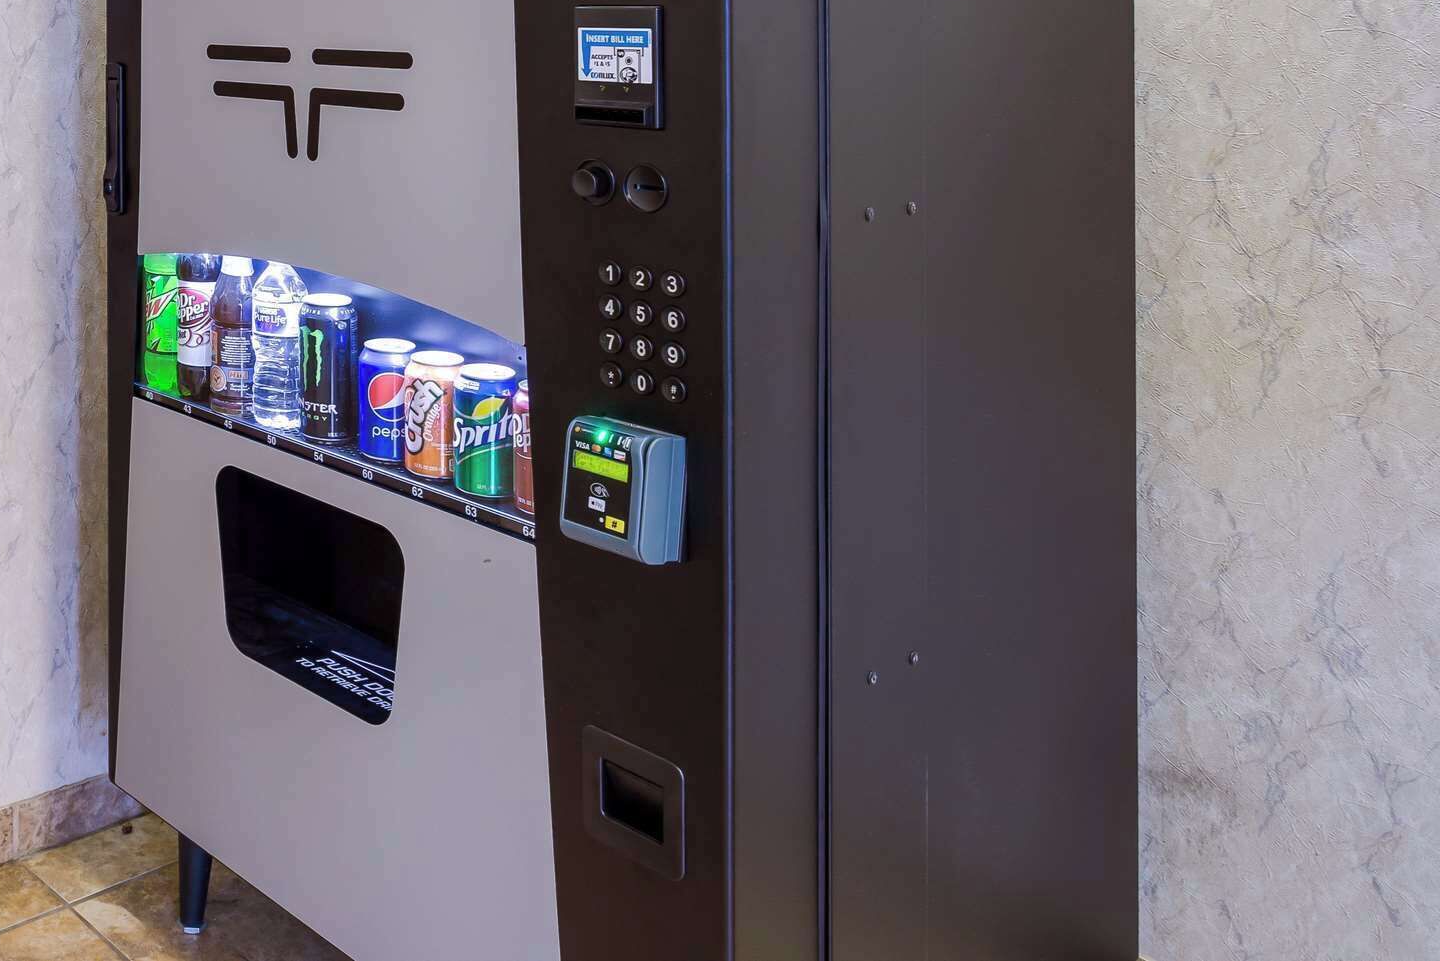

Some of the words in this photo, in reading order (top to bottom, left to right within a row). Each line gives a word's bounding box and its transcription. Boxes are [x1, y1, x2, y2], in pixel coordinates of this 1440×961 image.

[586, 33, 609, 43] INSERT
[610, 35, 625, 44] BILL
[626, 35, 644, 44] HERE
[605, 264, 613, 281] 1
[635, 270, 645, 287] 2
[666, 275, 677, 293] 3
[178, 301, 209, 323] pper
[604, 299, 615, 316] 4
[636, 305, 646, 323] 5
[667, 311, 678, 329] 6
[271, 315, 287, 327] Life
[606, 333, 615, 351] 7
[636, 339, 646, 357] 8
[667, 346, 678, 364] 9
[637, 375, 646, 392] 0
[183, 404, 192, 414] 43
[298, 396, 338, 415] NSTER
[405, 378, 445, 454] Crush
[223, 419, 233, 430] 45
[372, 425, 406, 441] peps
[267, 434, 277, 446] 50
[575, 440, 590, 450] VISA
[313, 452, 324, 464] 54
[362, 469, 373, 481] 60
[411, 486, 423, 499] 62
[465, 505, 477, 518] 63
[522, 526, 536, 539] 64
[295, 657, 315, 667] TO
[311, 666, 372, 697] RETRIEVE
[316, 657, 369, 682] PUSH
[363, 682, 395, 701] DO
